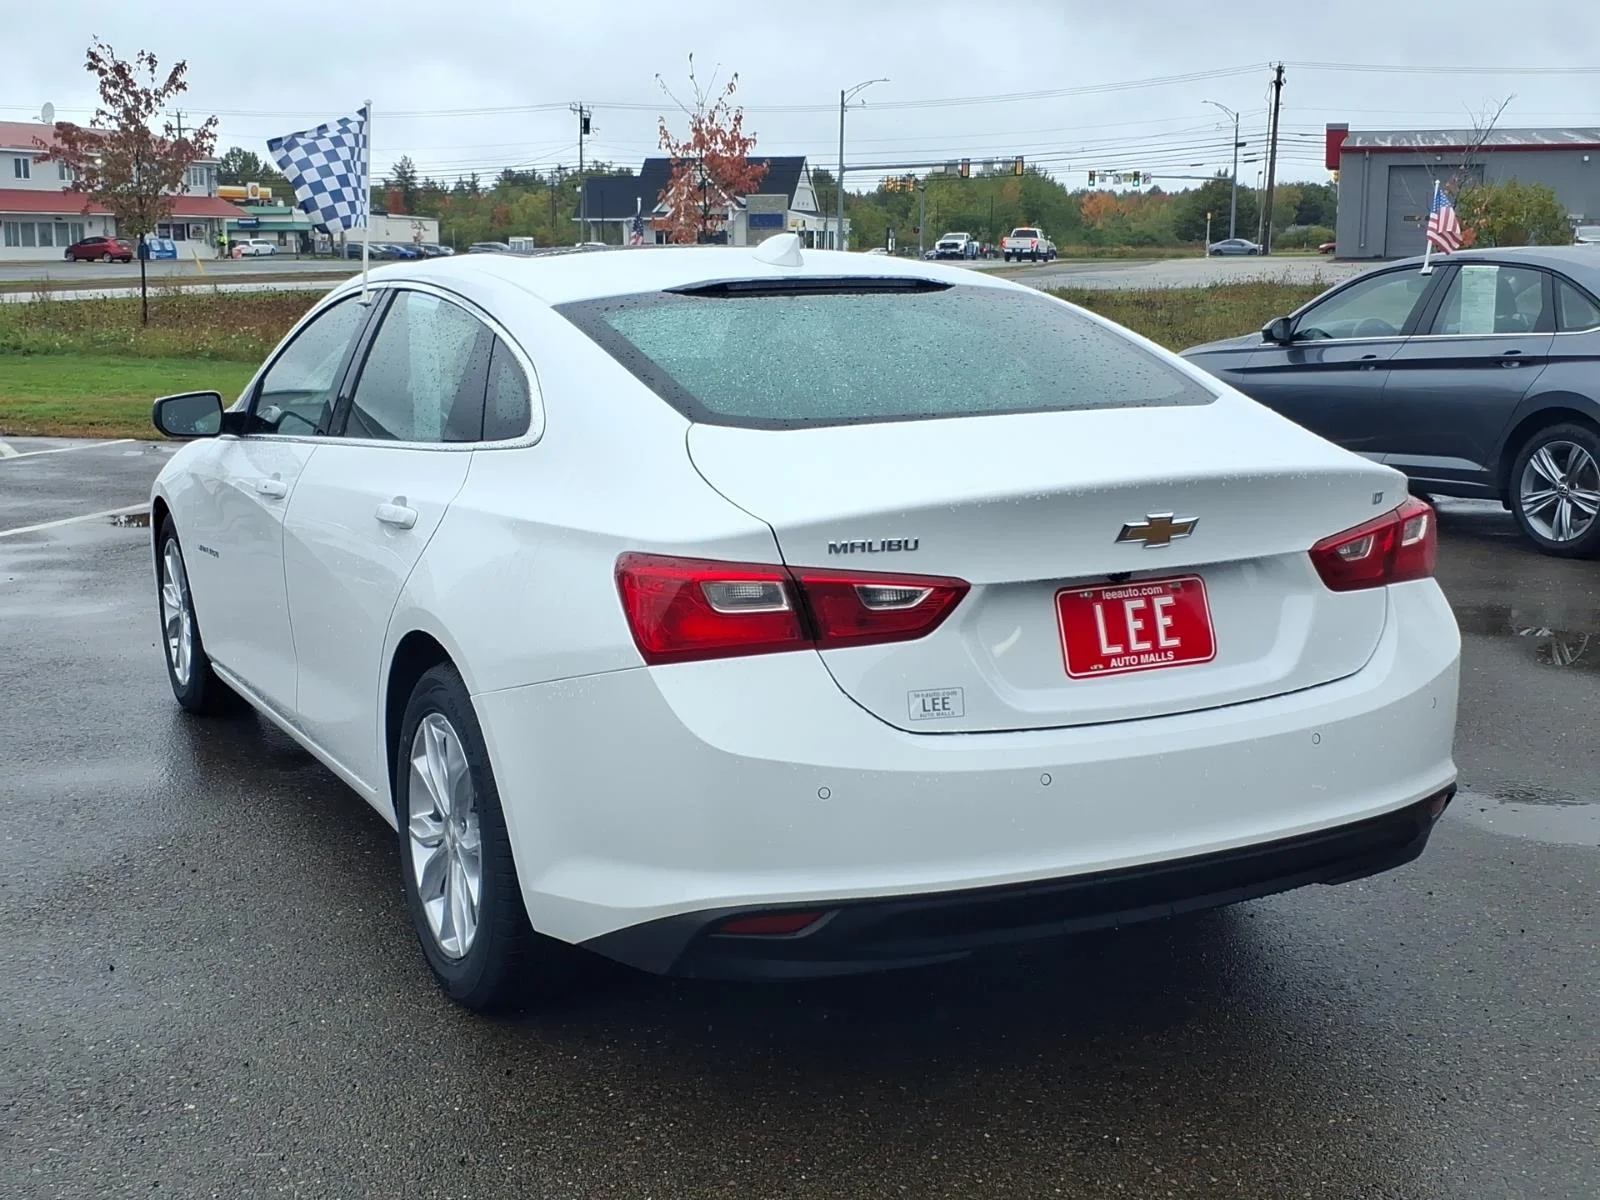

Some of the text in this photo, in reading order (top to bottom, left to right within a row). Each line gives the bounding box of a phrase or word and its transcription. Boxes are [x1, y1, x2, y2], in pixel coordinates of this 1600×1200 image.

[828, 537, 919, 555] MALIBU
[1102, 585, 1163, 600] leeauto.com
[1093, 596, 1181, 656] LEE
[1110, 655, 1138, 668] AUTO
[1140, 651, 1175, 664] MALLS
[922, 697, 951, 712] LEE
